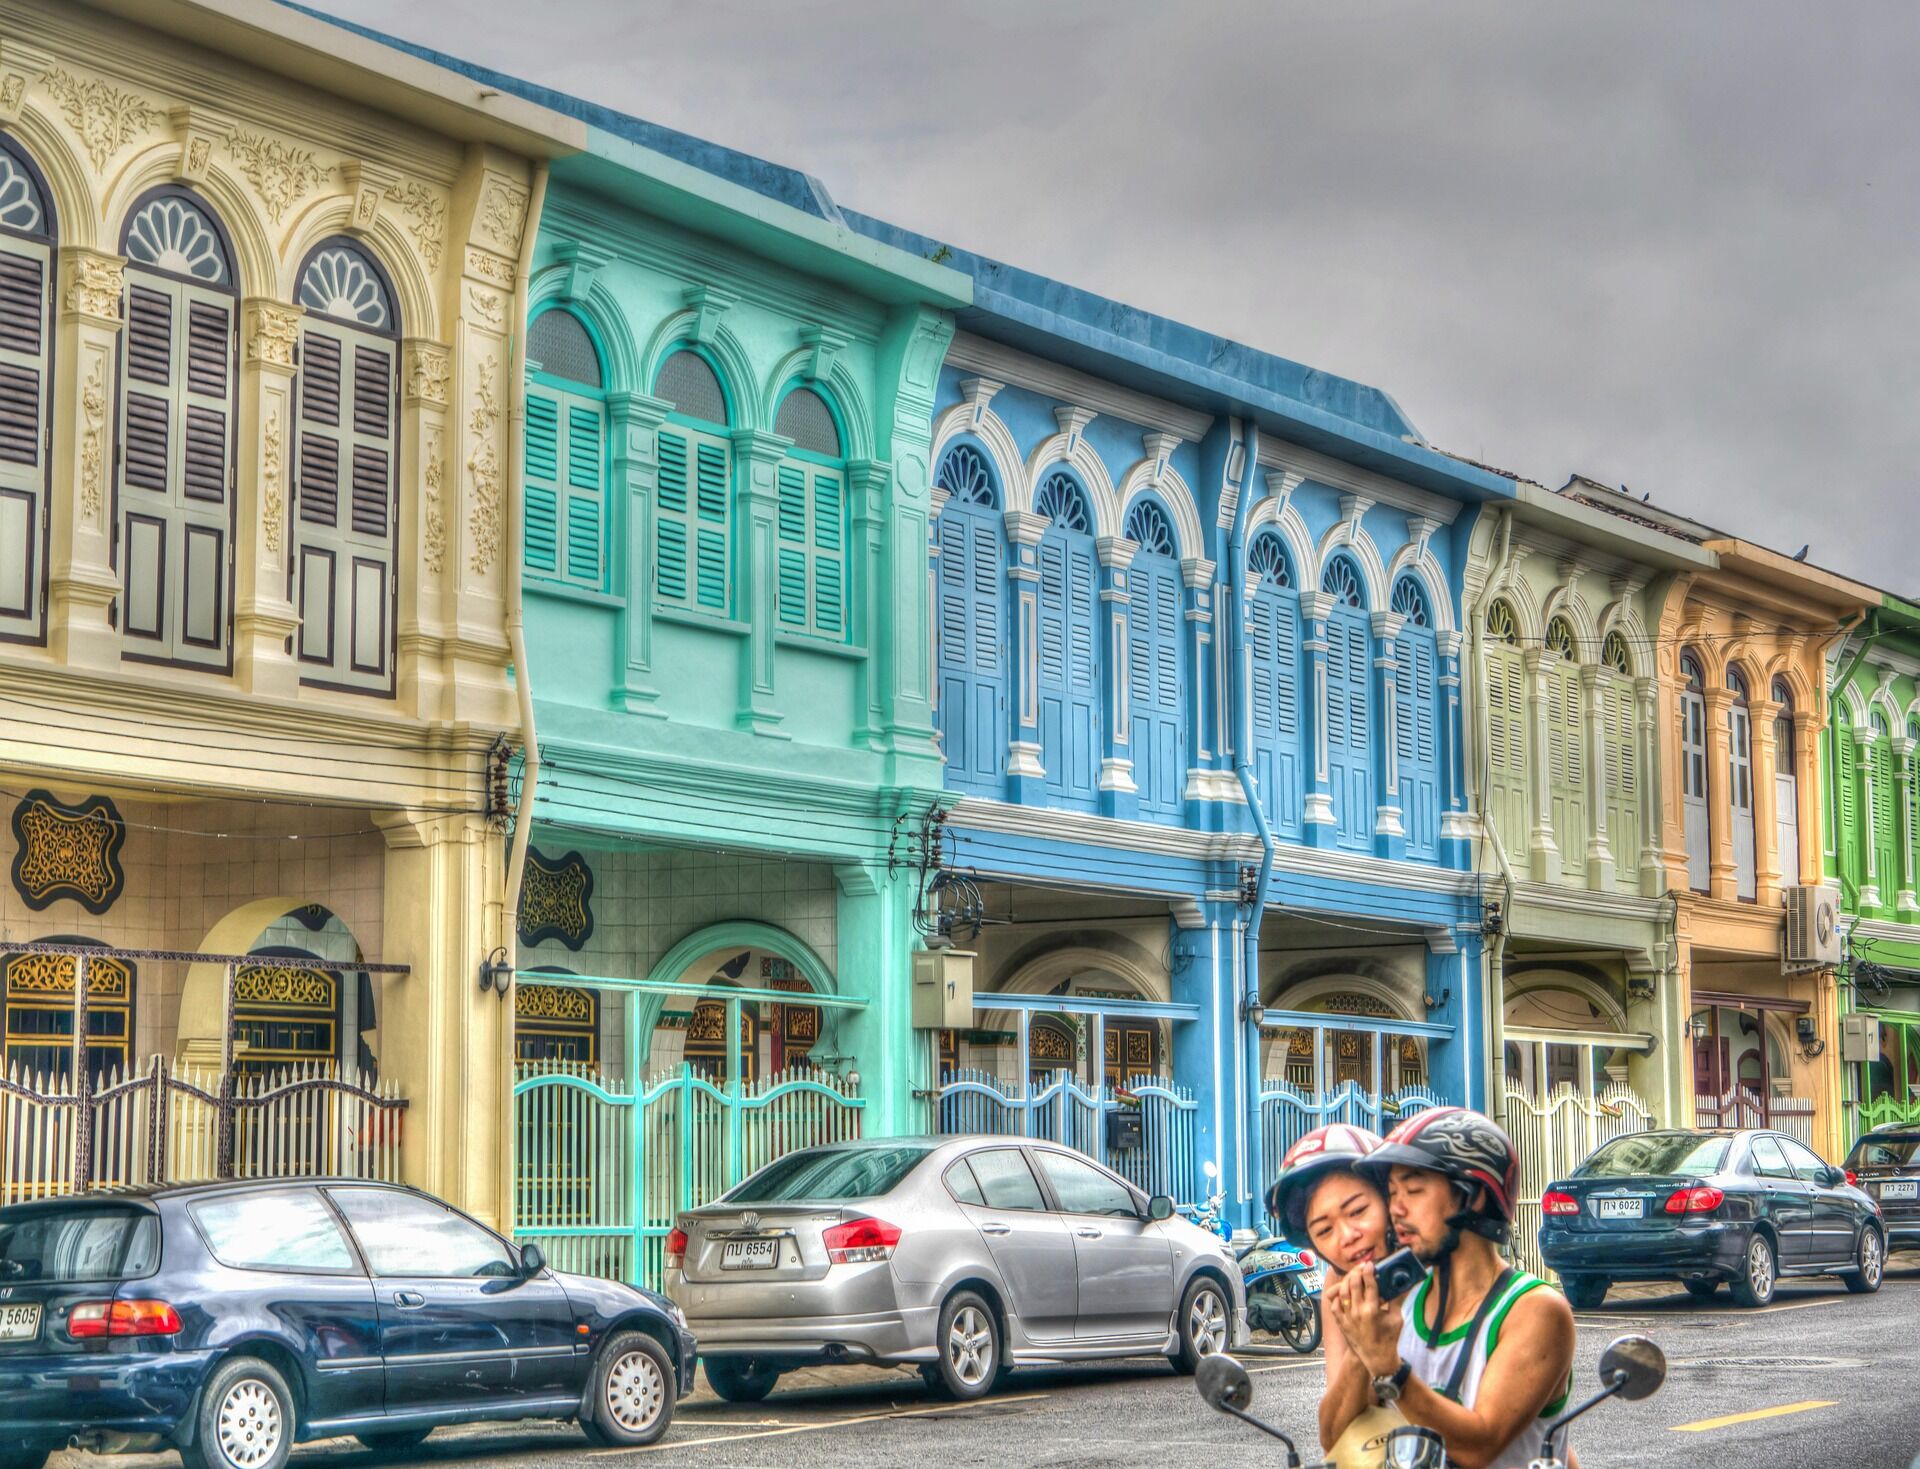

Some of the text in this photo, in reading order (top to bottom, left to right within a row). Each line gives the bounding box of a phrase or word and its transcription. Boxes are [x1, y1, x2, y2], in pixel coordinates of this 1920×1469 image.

[1618, 1200, 1640, 1210] 6022
[746, 1242, 773, 1256] 6554
[6, 1308, 37, 1325] 5605
